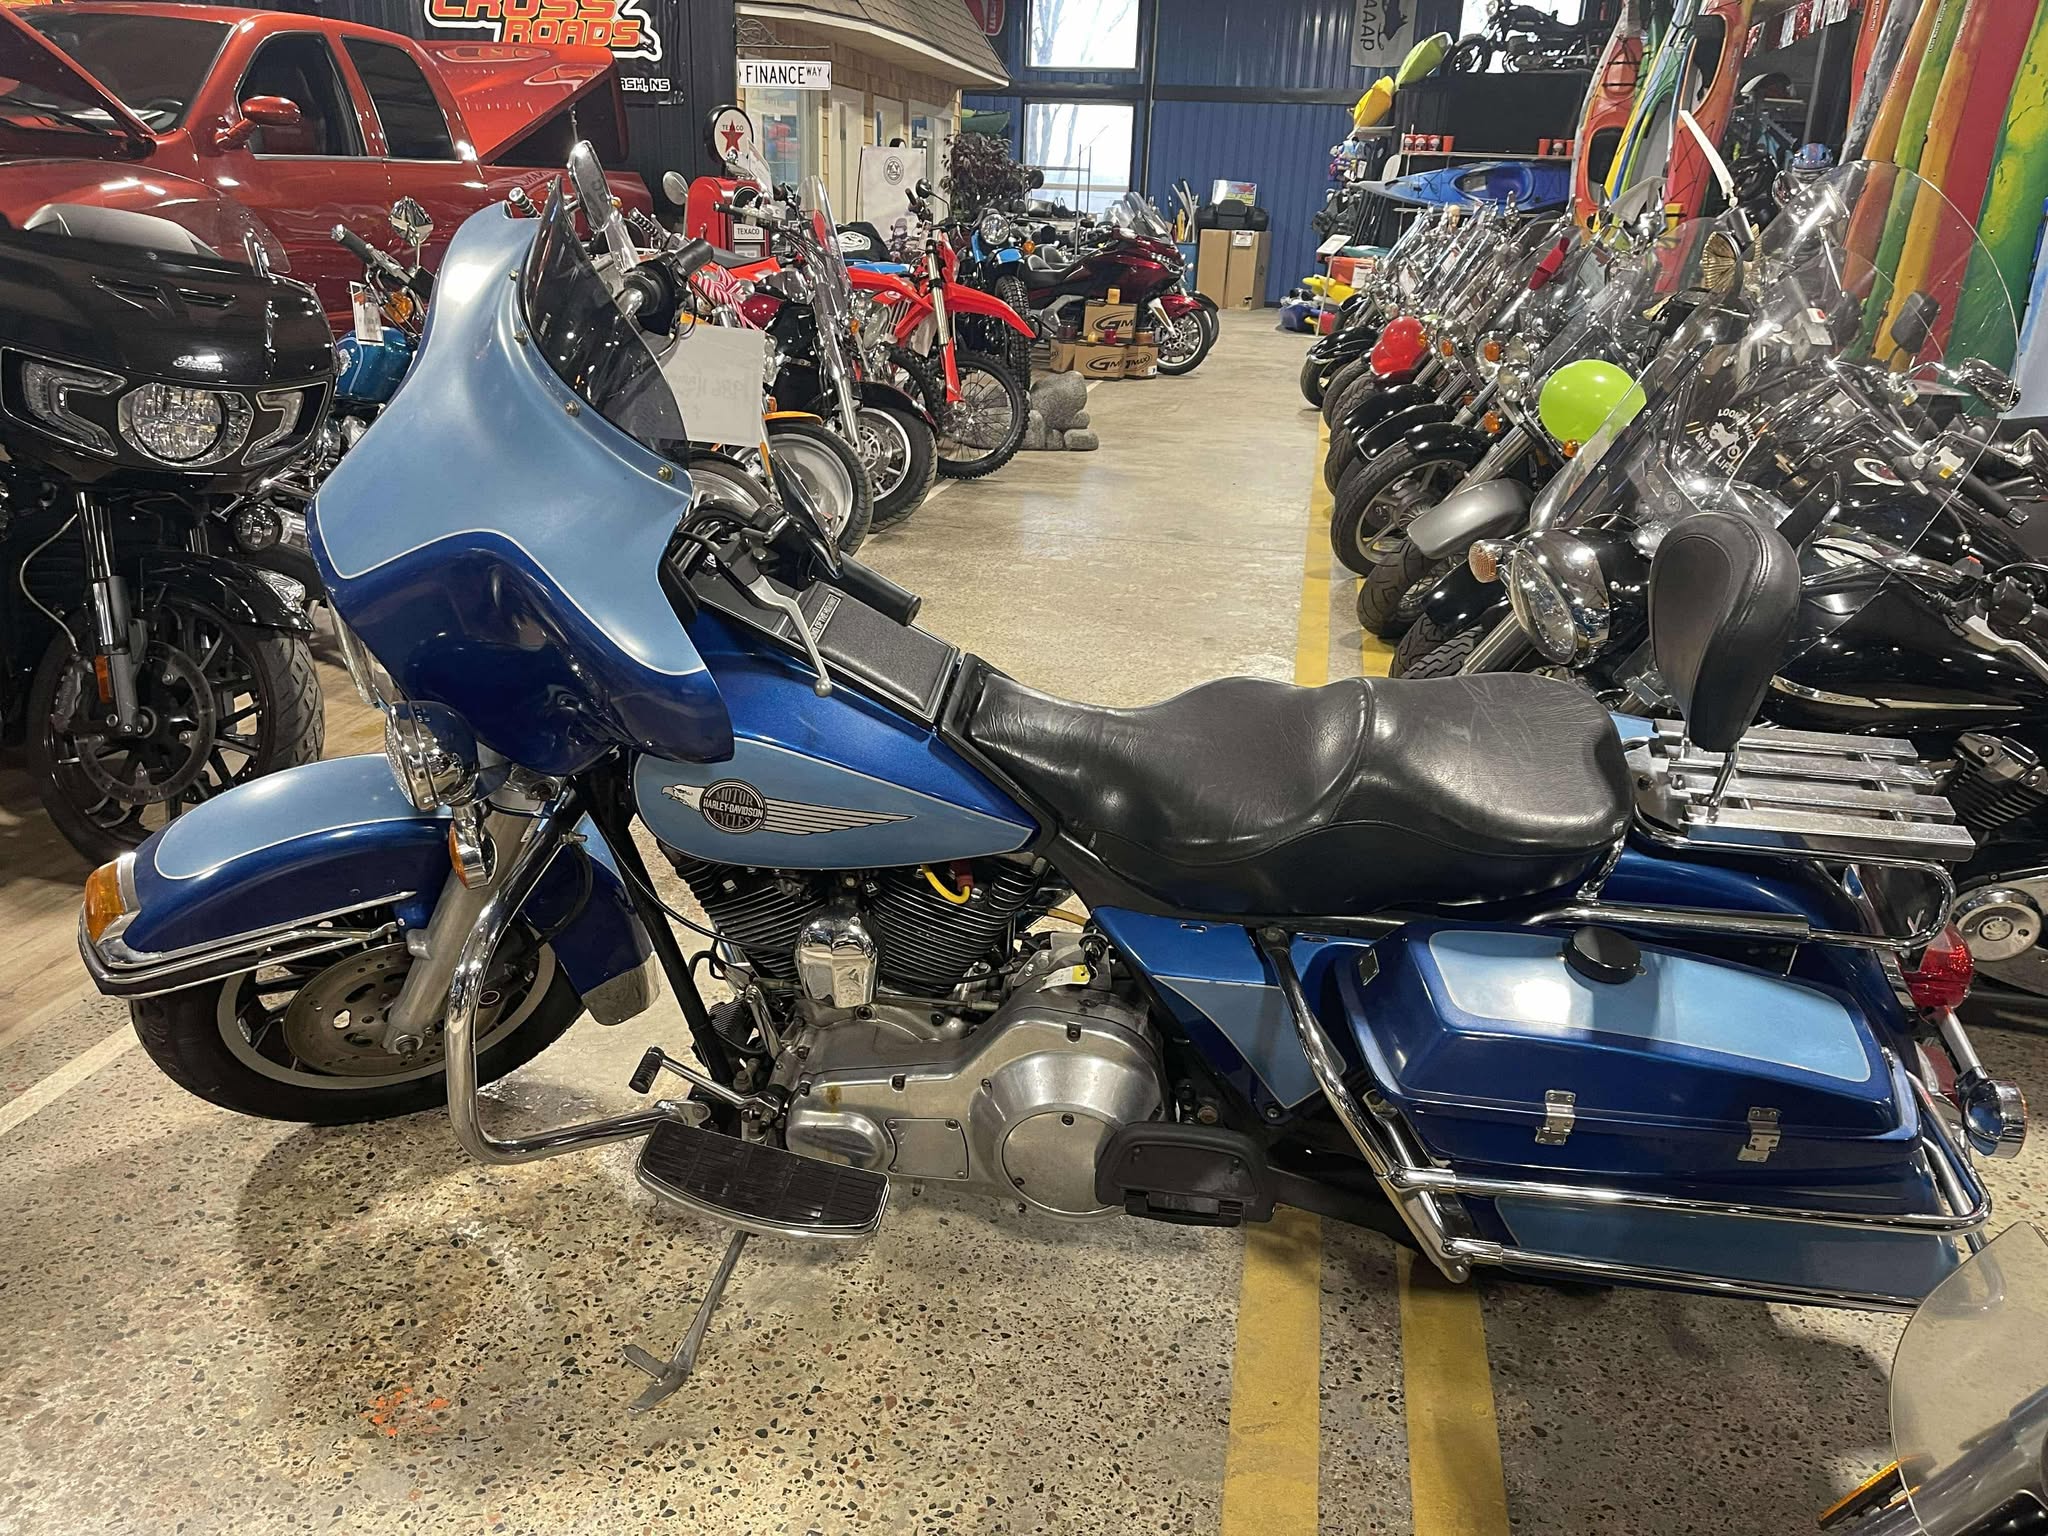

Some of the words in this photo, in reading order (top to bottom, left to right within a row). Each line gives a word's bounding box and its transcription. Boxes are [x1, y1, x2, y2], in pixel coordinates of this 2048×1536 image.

[432, 0, 618, 20] CROSS
[502, 19, 641, 47] ROADS
[650, 78, 670, 91] NS
[745, 65, 806, 84] FINANCE
[806, 67, 822, 76] WAY
[1718, 408, 1742, 420] LOOK
[1742, 422, 1757, 448] WICE
[1695, 431, 1714, 454] SAVE
[1714, 455, 1737, 476] LIFE
[713, 787, 754, 806] MOTOR
[703, 798, 764, 818] HARLEY-DAVIDSON
[713, 810, 752, 829] CYCLES
